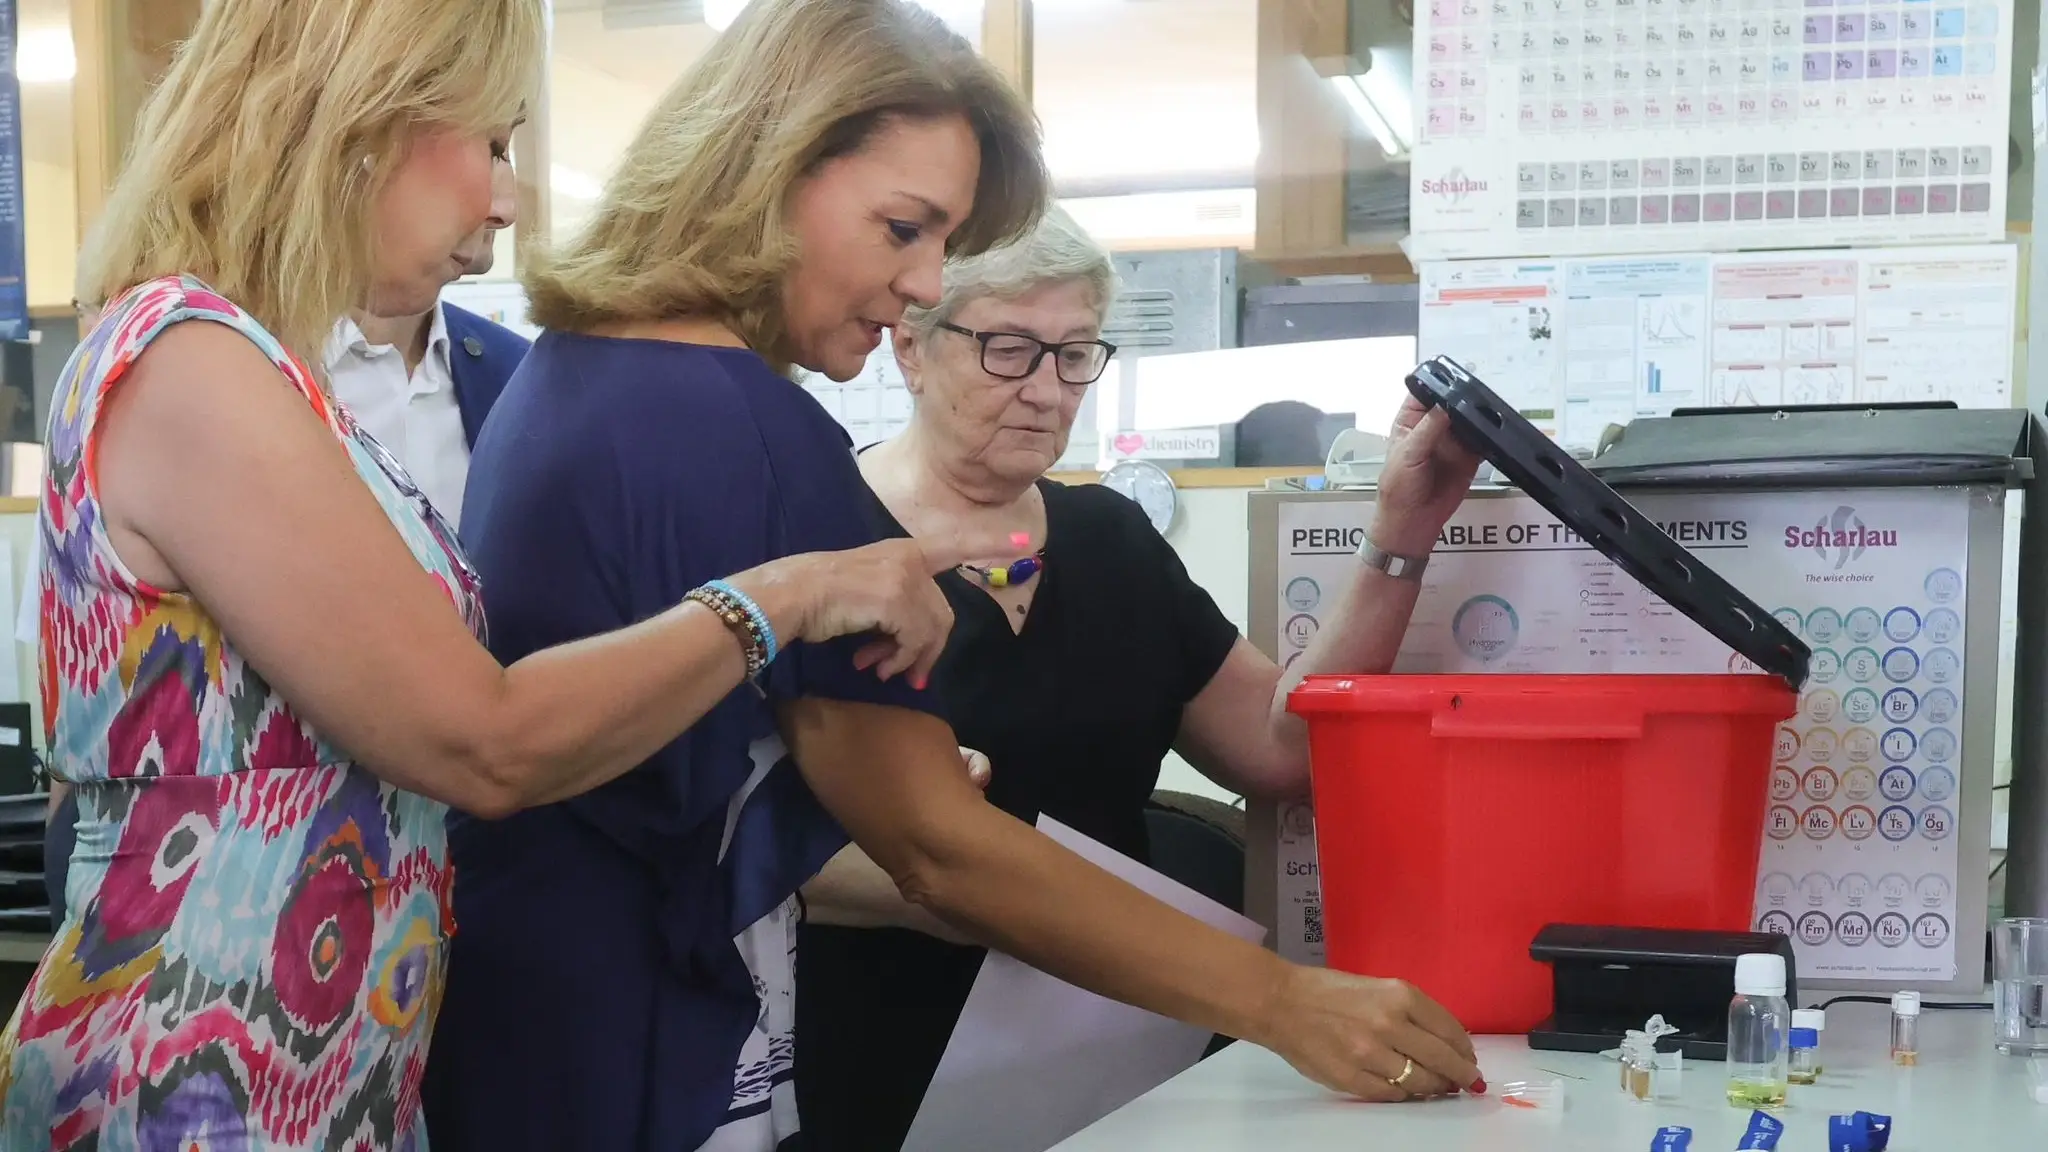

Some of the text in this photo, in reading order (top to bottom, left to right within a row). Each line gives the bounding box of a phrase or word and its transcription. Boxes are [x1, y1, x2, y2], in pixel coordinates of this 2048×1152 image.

[1421, 179, 1488, 194] Scharlau
[1143, 435, 1215, 454] chemistry
[1292, 520, 1748, 547] PERIO ABLE OF TH MENTS
[1785, 525, 1898, 548] Scharlau
[1804, 573, 1874, 582] The wise choice
[1297, 626, 1308, 636] Li
[1818, 660, 1828, 670] P
[1857, 660, 1866, 670] S
[1852, 701, 1868, 711] Se
[1893, 701, 1908, 711] Br
[1774, 779, 1790, 789] Pb
[1890, 779, 1904, 789] At
[1775, 817, 1786, 827] Fl
[1809, 818, 1829, 828] Mc
[1850, 818, 1865, 828] Lv
[1890, 817, 1903, 829] Ts
[1925, 818, 1944, 830] Og
[1286, 861, 1318, 876] Sch
[1769, 924, 1784, 933] Es
[1805, 925, 1825, 934] Fm
[1843, 925, 1863, 935] Md
[1883, 925, 1901, 936] No
[1924, 926, 1938, 936] Lr
